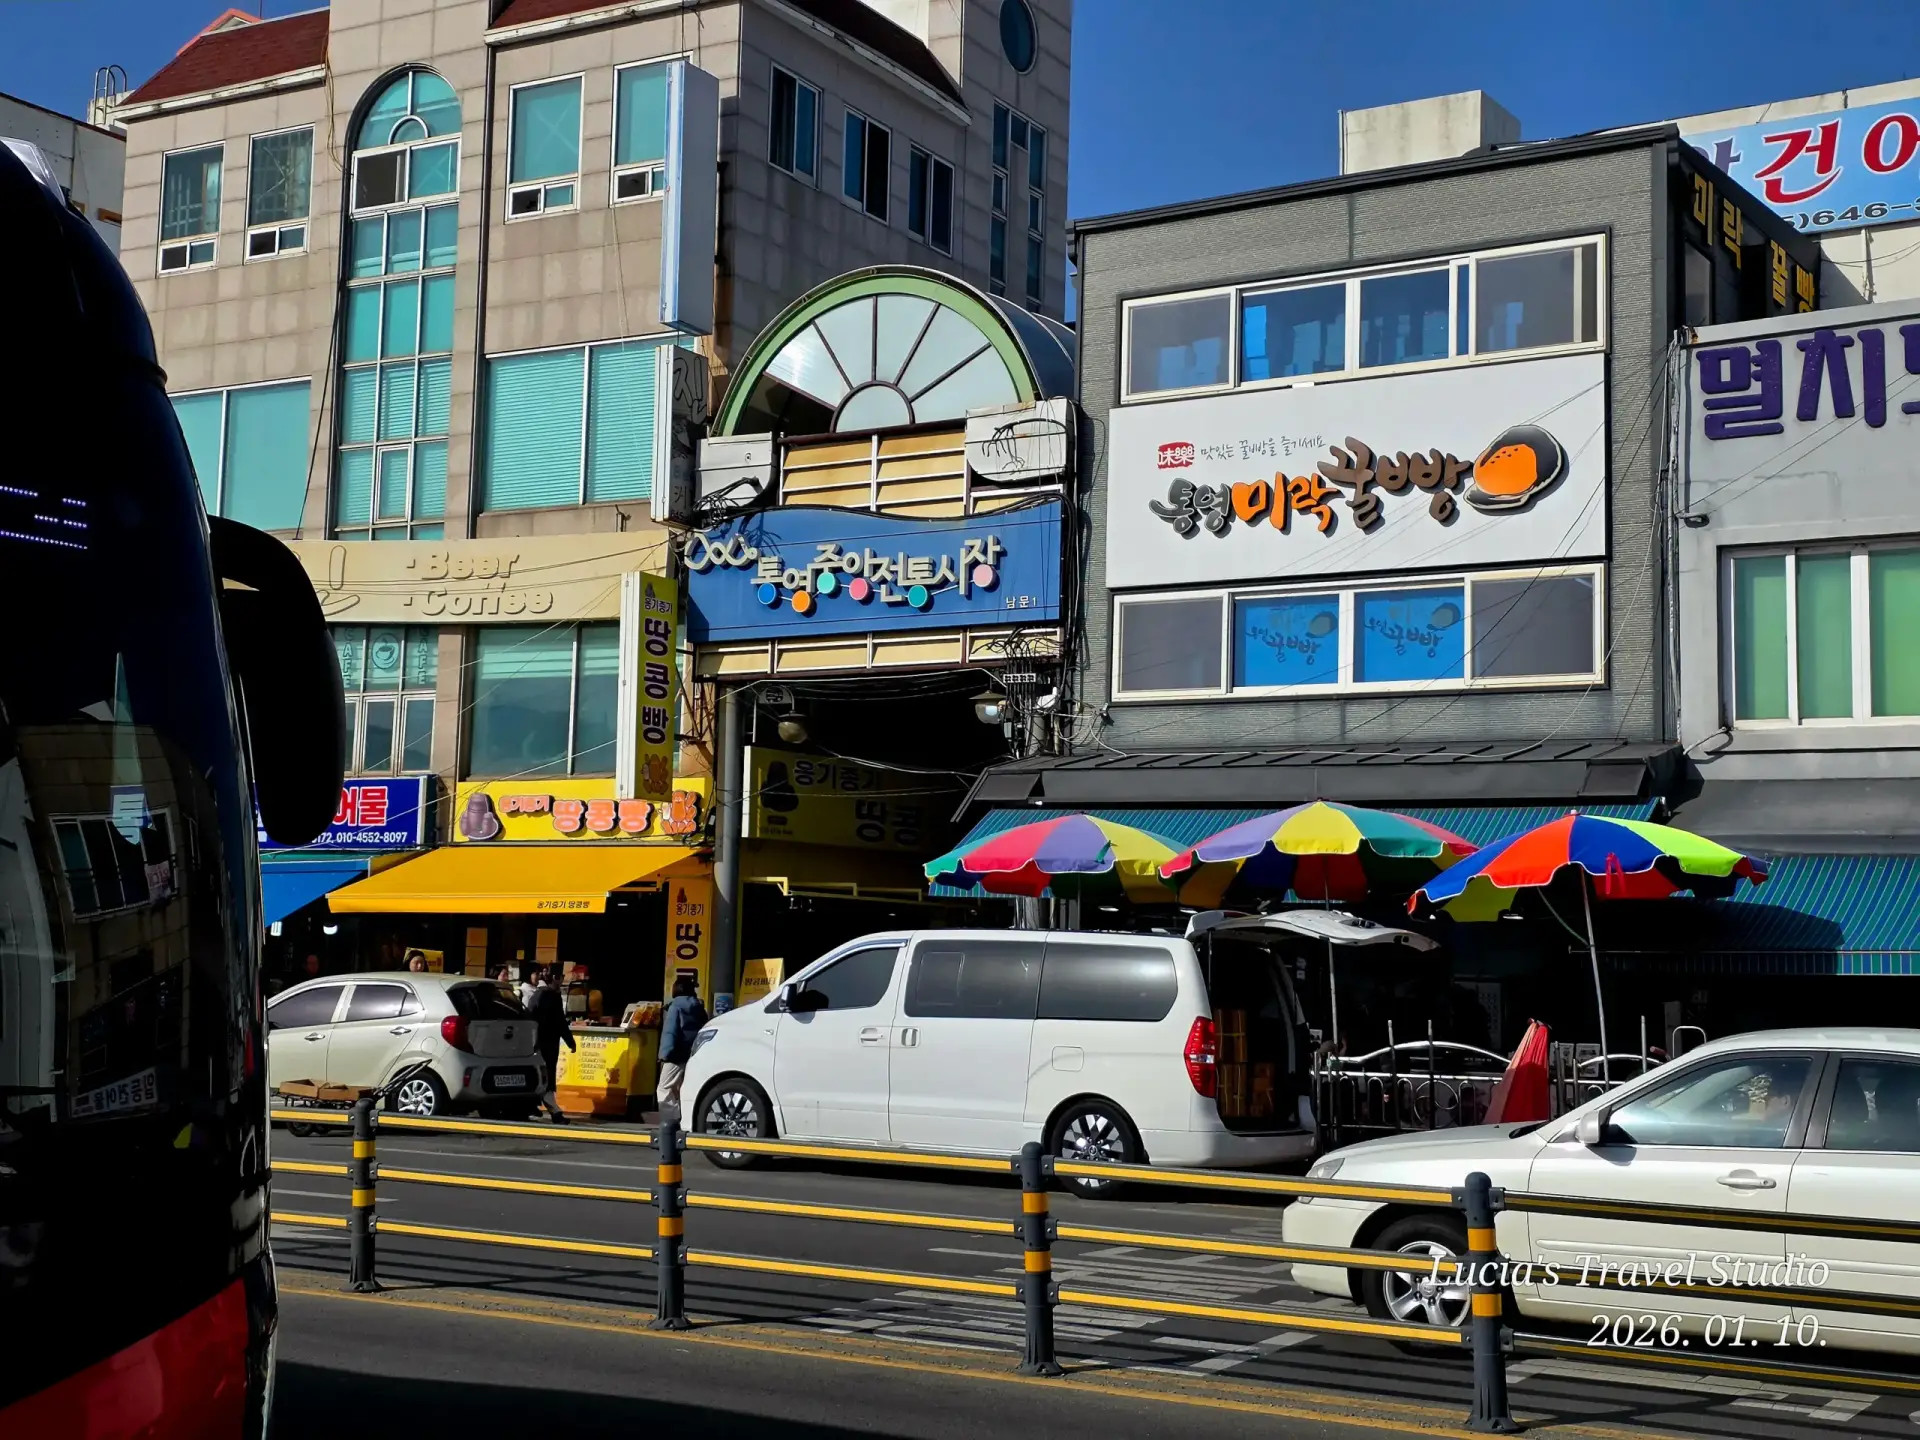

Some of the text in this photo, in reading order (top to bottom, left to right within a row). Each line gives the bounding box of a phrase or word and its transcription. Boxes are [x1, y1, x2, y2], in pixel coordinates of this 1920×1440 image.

[1693, 173, 1744, 271] 미락
[1696, 323, 1920, 441] 멸치
[1200, 443, 1235, 461] 맛있는
[1280, 434, 1326, 456] 즐기세요
[421, 551, 520, 580] Beer
[422, 583, 554, 616] Coffee
[641, 618, 672, 745] 땅콩빵
[552, 799, 652, 833] 땅콩빵
[336, 831, 408, 844] 010-4552-8097
